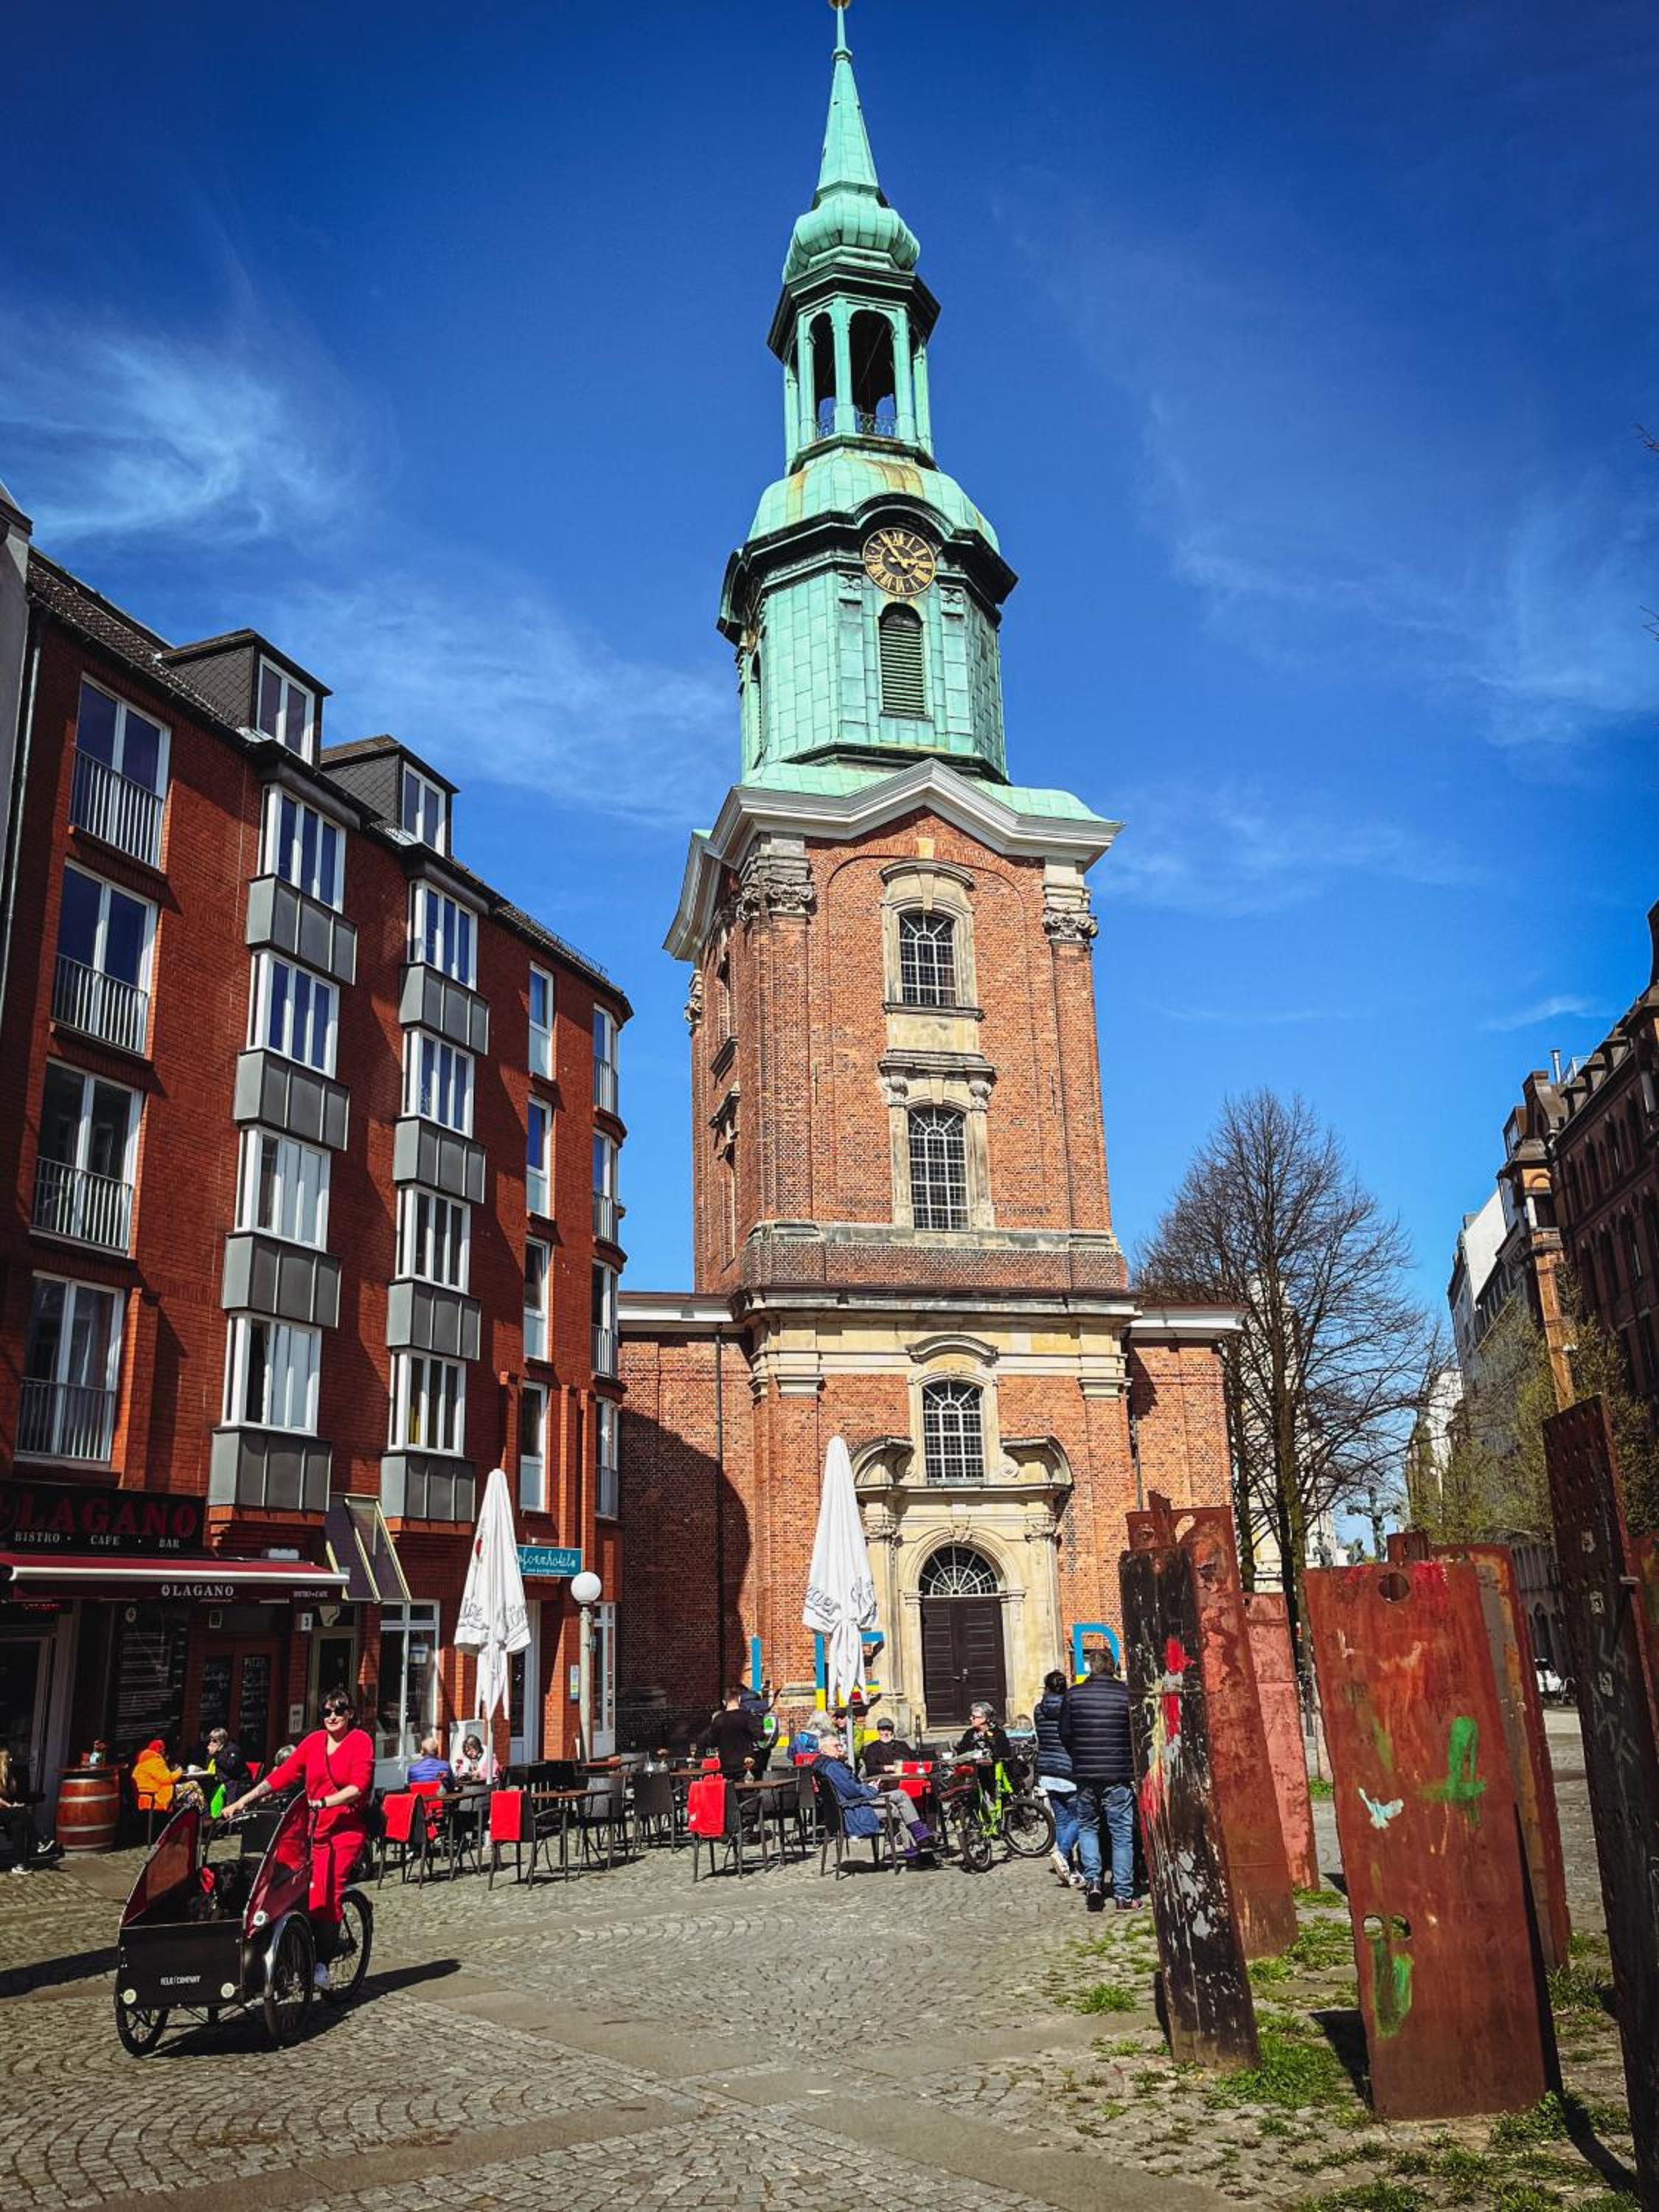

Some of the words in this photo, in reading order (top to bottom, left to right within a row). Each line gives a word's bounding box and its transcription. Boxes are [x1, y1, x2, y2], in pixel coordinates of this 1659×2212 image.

[15, 1531, 60, 1543] BISTRO
[159, 1539, 180, 1548] BAR
[161, 1584, 234, 1597] OLAGANO
